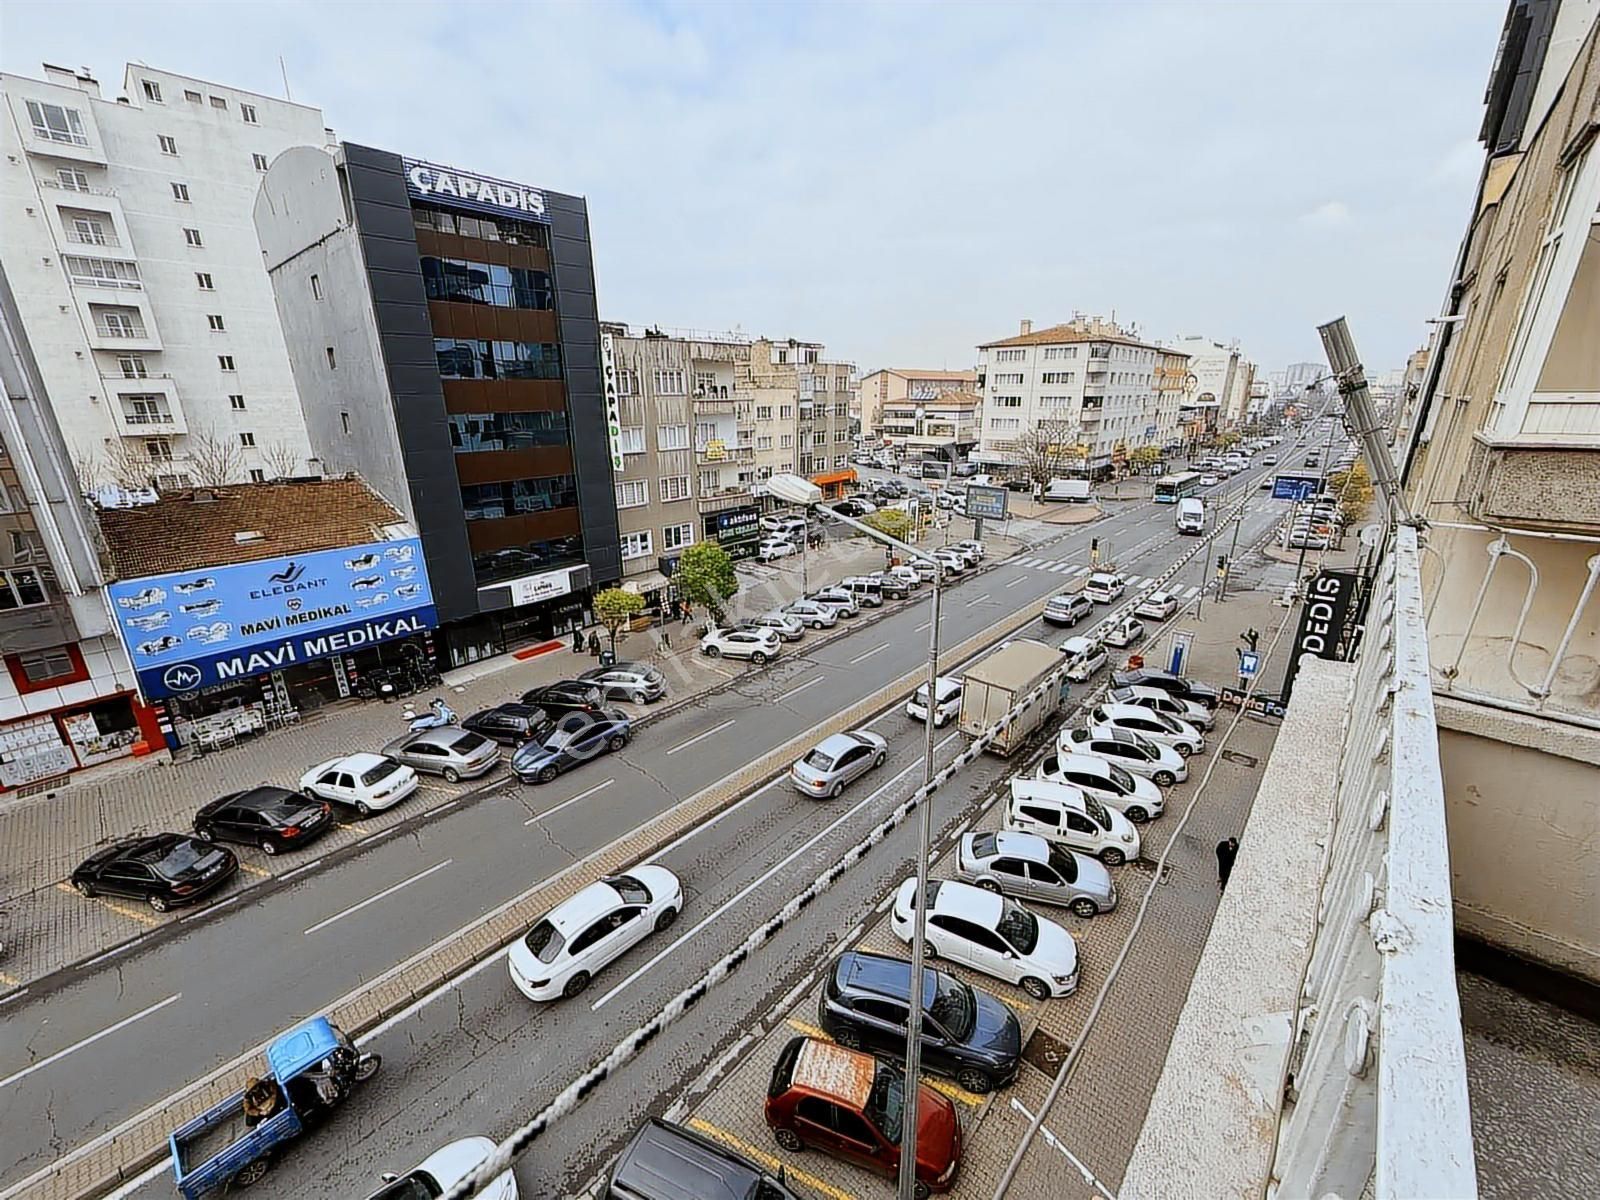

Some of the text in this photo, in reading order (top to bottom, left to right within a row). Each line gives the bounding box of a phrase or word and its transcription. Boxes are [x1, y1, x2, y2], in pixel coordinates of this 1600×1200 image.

[250, 578, 328, 600] ELEGANT
[240, 604, 352, 636] MAVİ MEDİKAL
[216, 615, 426, 679] MAVİ MEDİKAL
